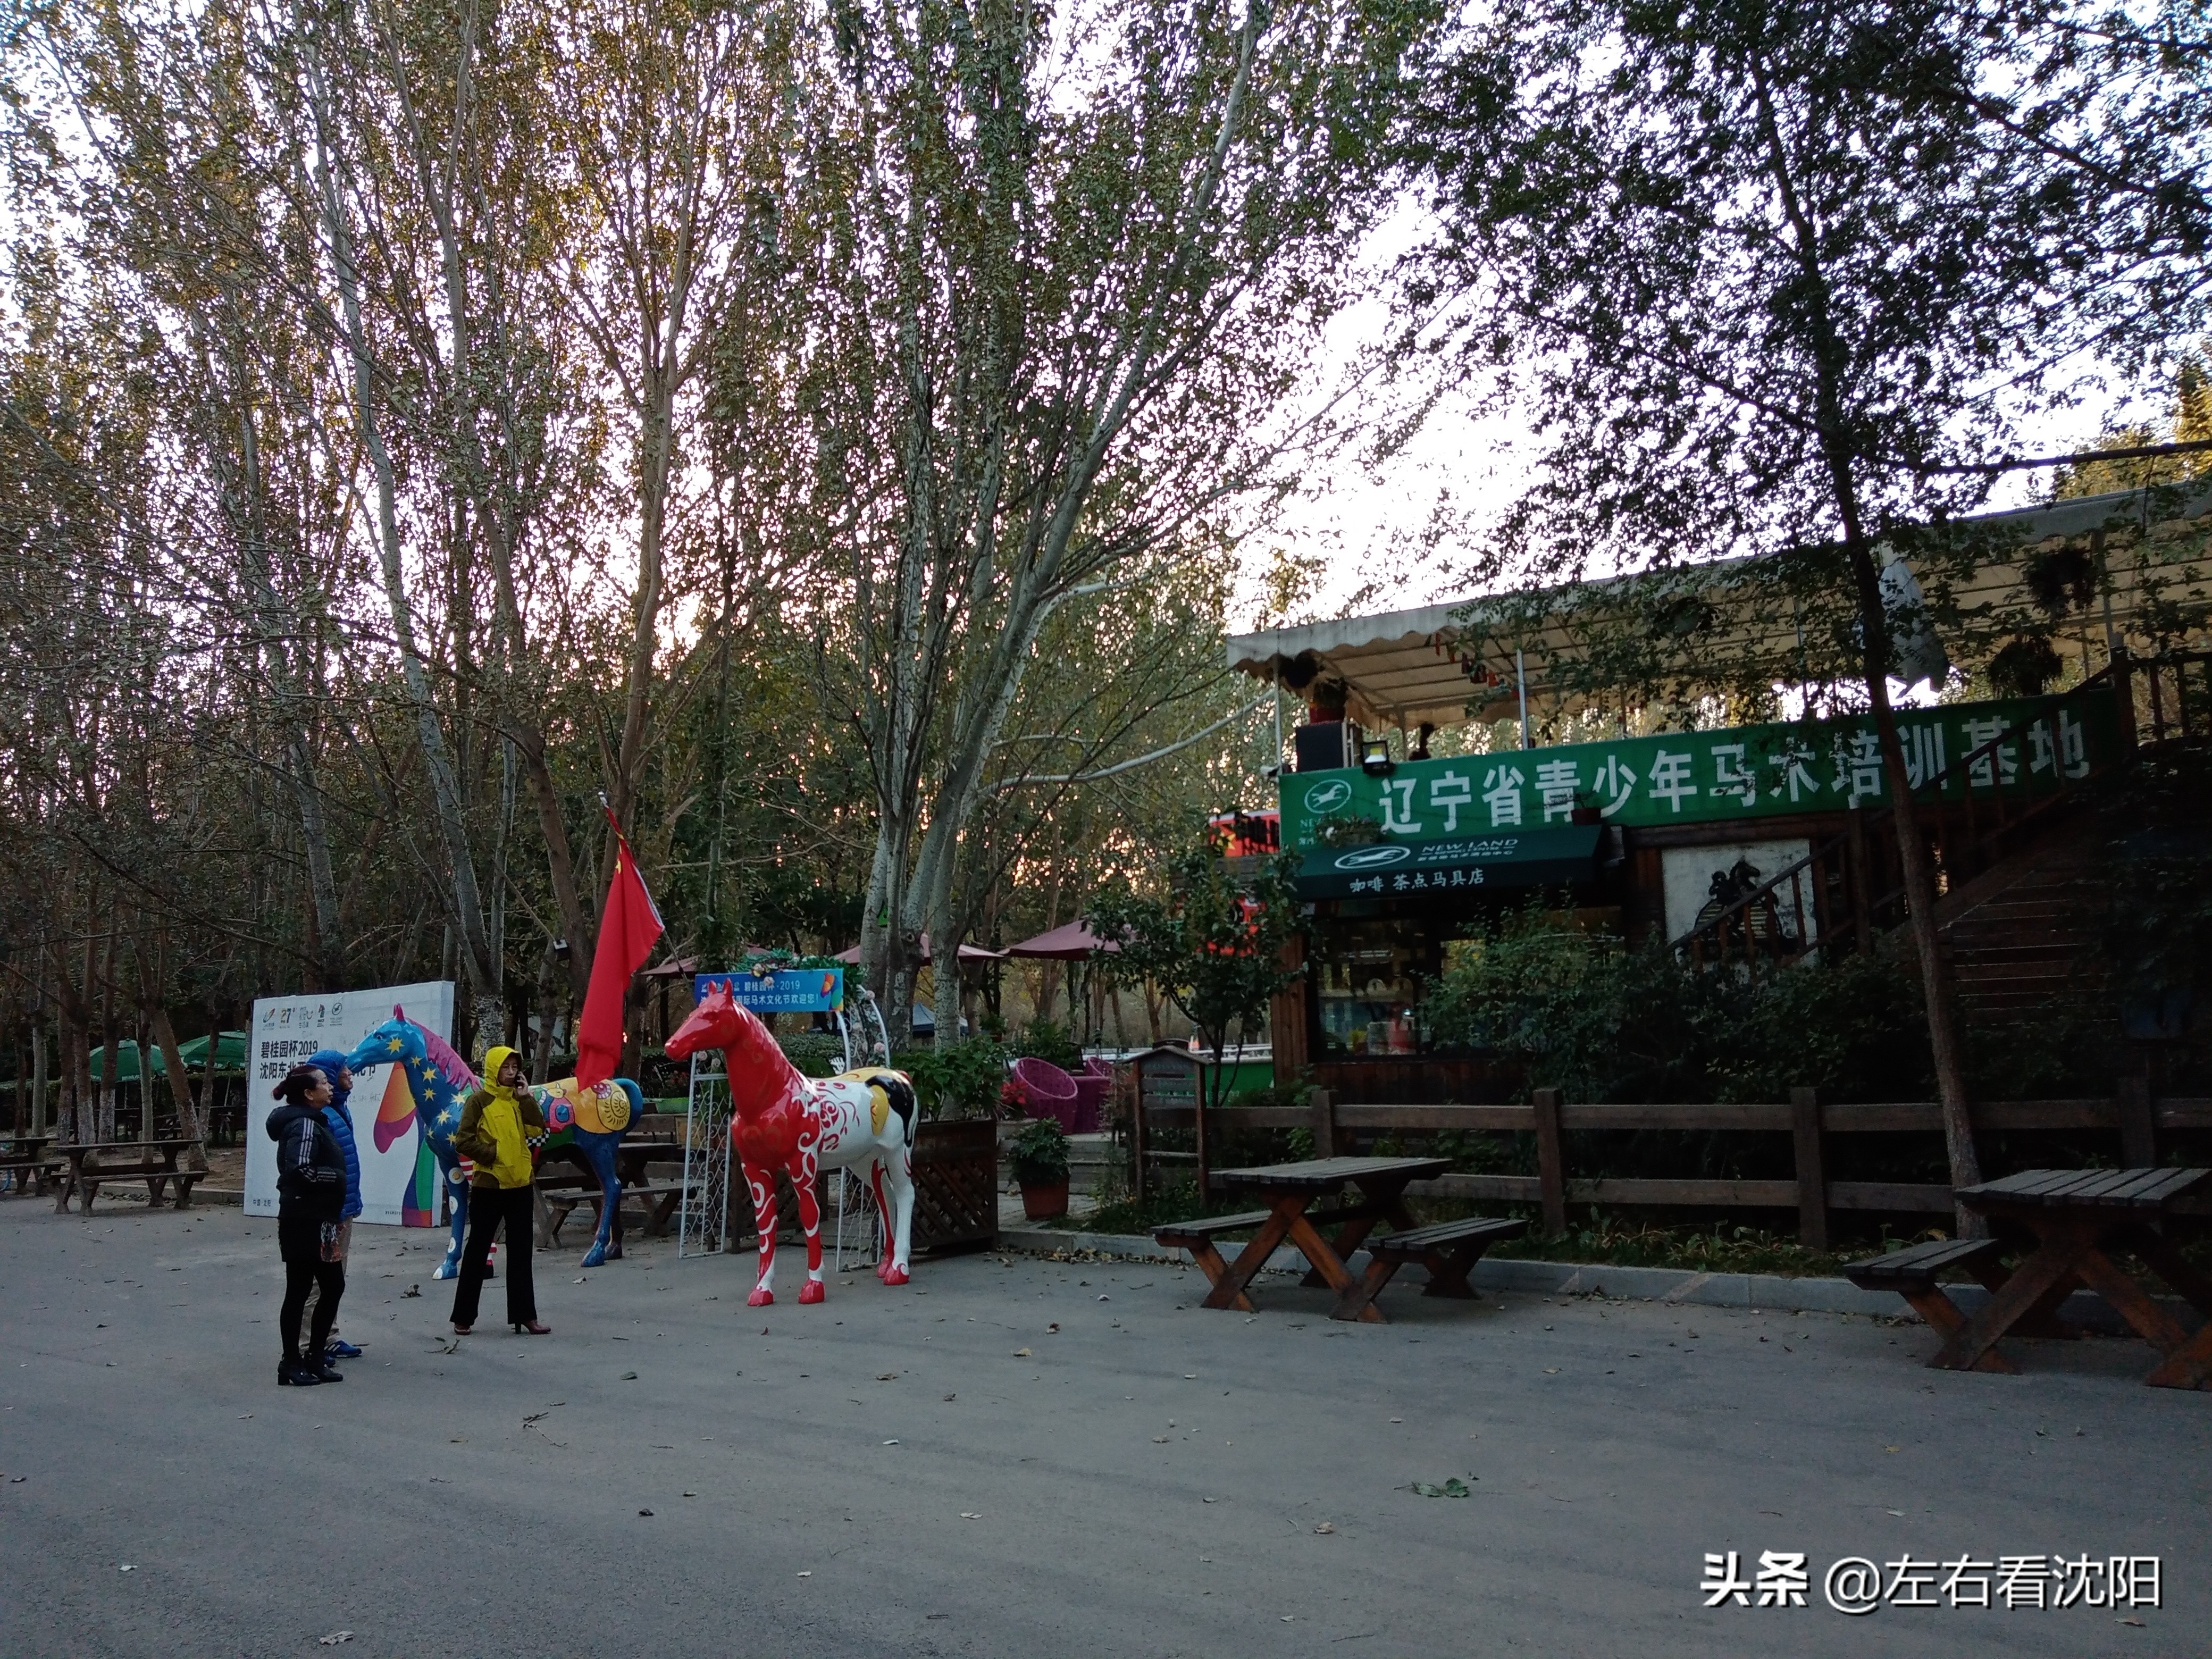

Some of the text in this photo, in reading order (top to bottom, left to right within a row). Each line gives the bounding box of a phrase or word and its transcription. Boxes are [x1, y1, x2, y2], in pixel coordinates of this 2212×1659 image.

[1378, 709, 2090, 834] 辽宁省青少年马术培训基地
[1422, 842, 1463, 852] NEW
[1350, 867, 1485, 893] 咖啡 茶点马具店
[261, 1040, 319, 1059] 碧桂园杯2019
